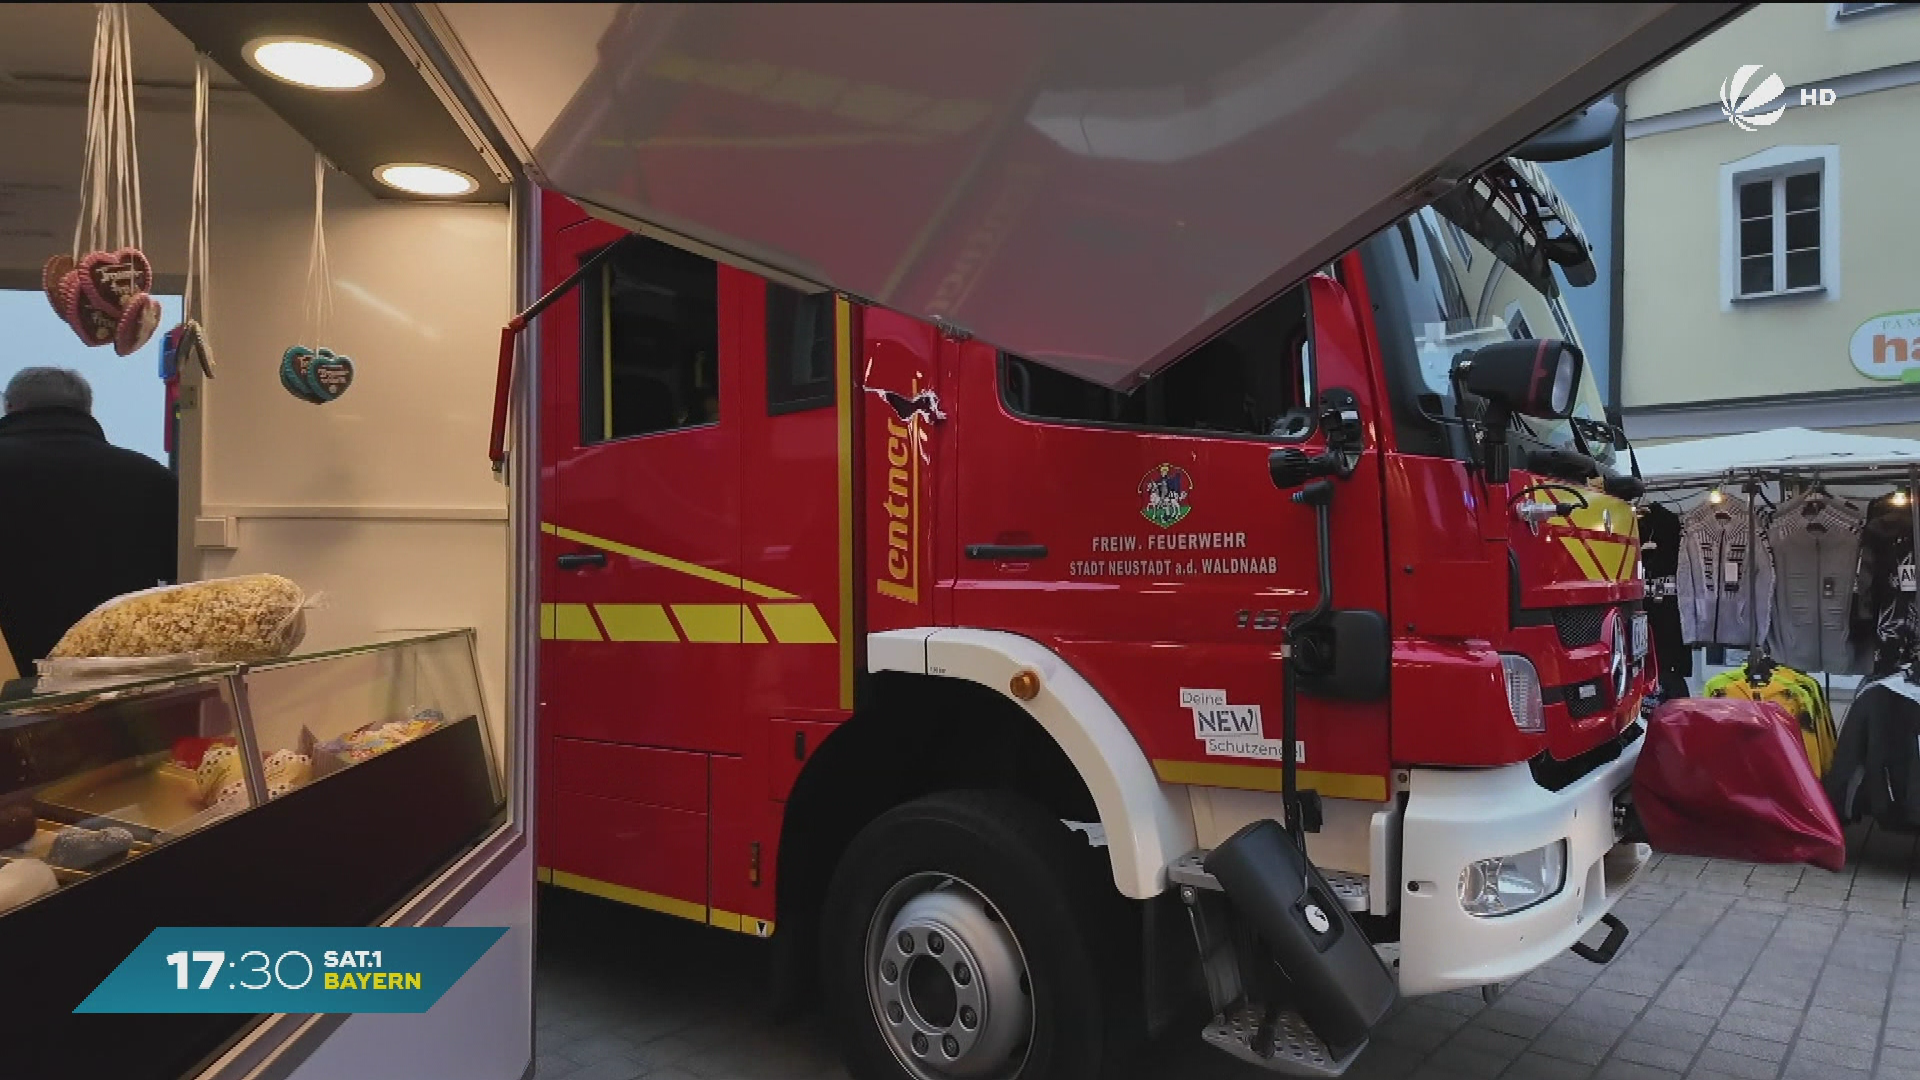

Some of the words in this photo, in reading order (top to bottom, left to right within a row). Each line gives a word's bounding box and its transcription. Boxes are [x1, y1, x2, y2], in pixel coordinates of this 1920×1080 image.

[876, 416, 918, 605] Lentner
[1092, 536, 1143, 552] FREIW.
[1148, 532, 1247, 550] FEUERWEHR
[1069, 559, 1105, 577] STADT
[1108, 559, 1172, 577] NEUSTADT
[1175, 558, 1198, 576] a.d.
[1201, 556, 1278, 575] WALDNAAB
[1182, 691, 1224, 706] Deine
[1198, 708, 1255, 732] NEW
[1208, 739, 1303, 759] Schutzenl
